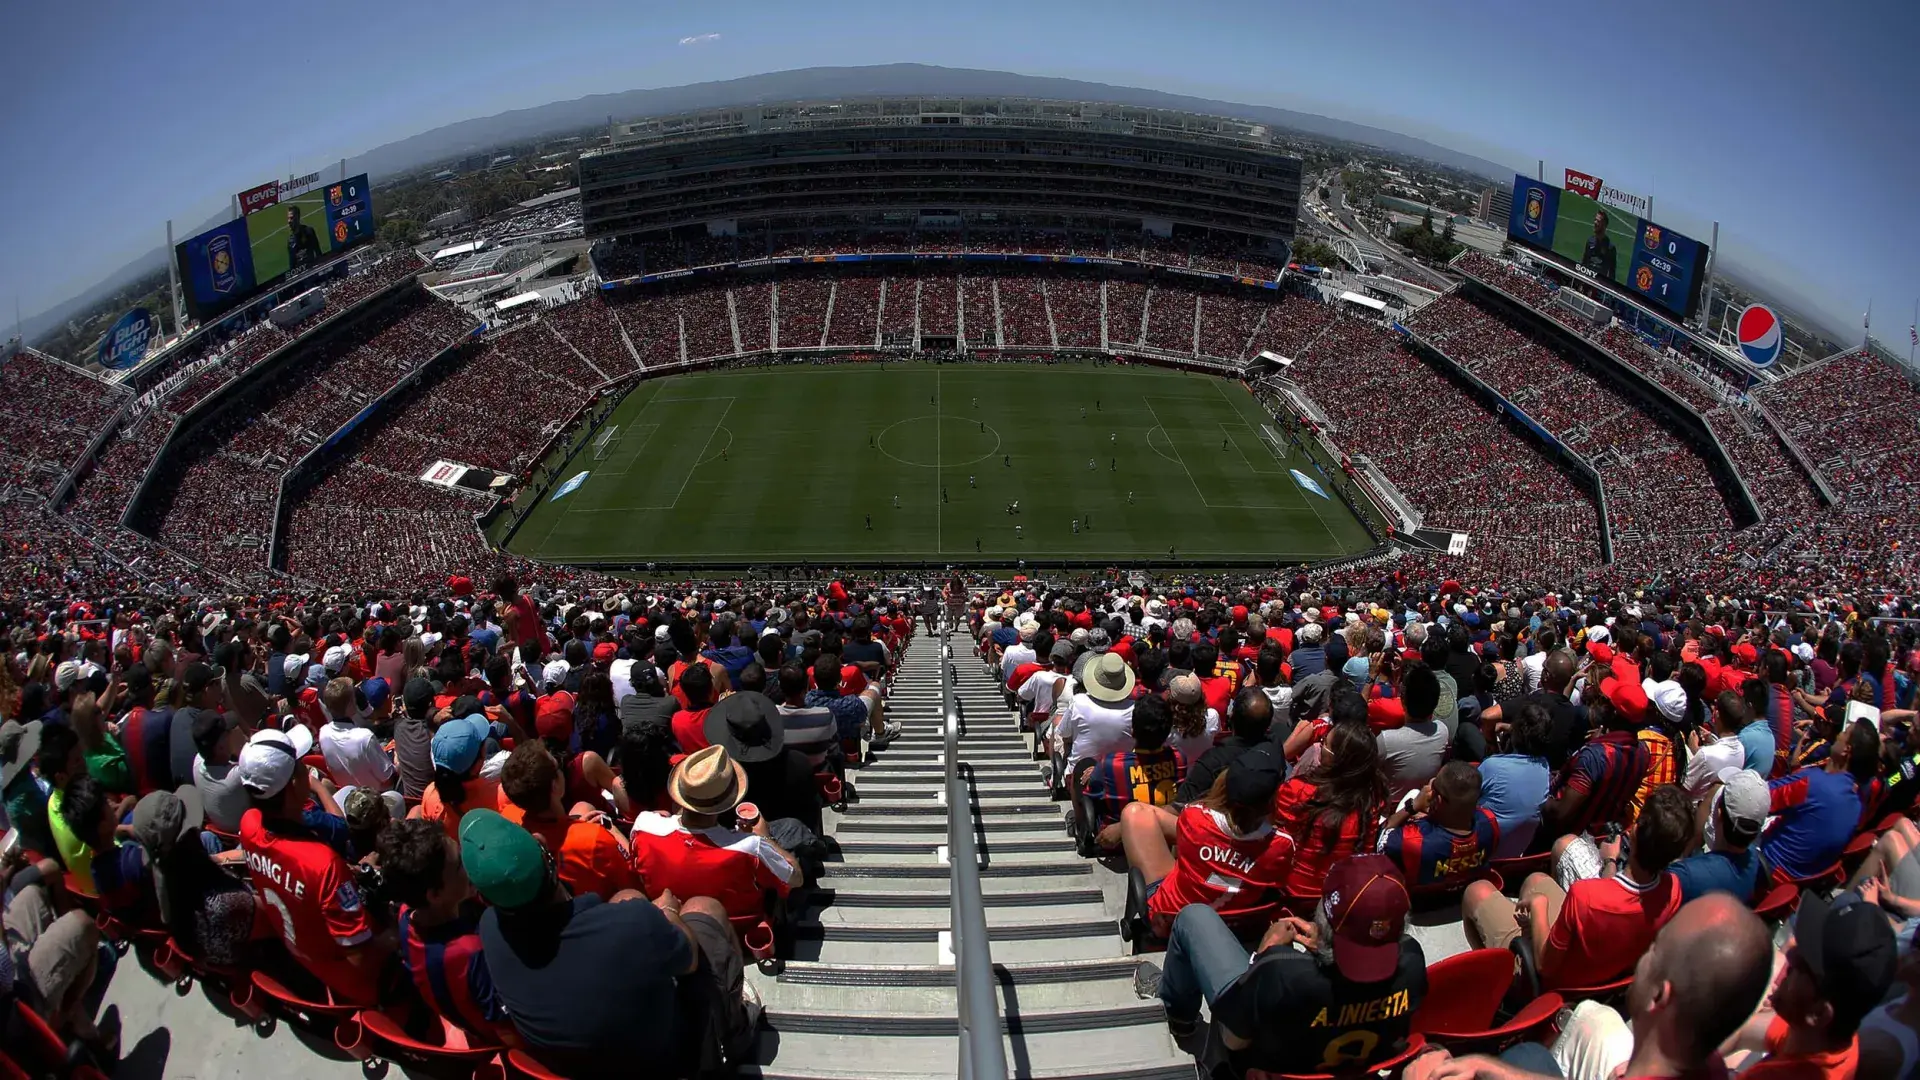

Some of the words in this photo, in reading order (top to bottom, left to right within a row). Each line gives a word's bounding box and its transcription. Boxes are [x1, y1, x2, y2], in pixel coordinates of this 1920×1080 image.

[280, 172, 320, 193] STADIUM
[349, 186, 356, 197] 0
[1602, 186, 1646, 210] STADIUM
[341, 205, 357, 217] 42:39
[354, 221, 360, 231] 1
[1668, 241, 1677, 255] 0
[285, 264, 308, 280] SONY
[738, 260, 771, 268] MANCHESTER
[1166, 267, 1200, 276] MANCHESTER
[1575, 263, 1599, 279] SONY
[1650, 257, 1672, 273] 42:39
[664, 270, 694, 279] BARCELONA
[1661, 282, 1668, 296] 1
[115, 319, 145, 343] BUD
[111, 327, 150, 360] LIGHT
[1130, 761, 1175, 784] MESSI
[1199, 845, 1256, 874] OWEN
[244, 849, 281, 885] HONG
[284, 871, 305, 901] LE
[1336, 987, 1409, 1028] INIESTA
